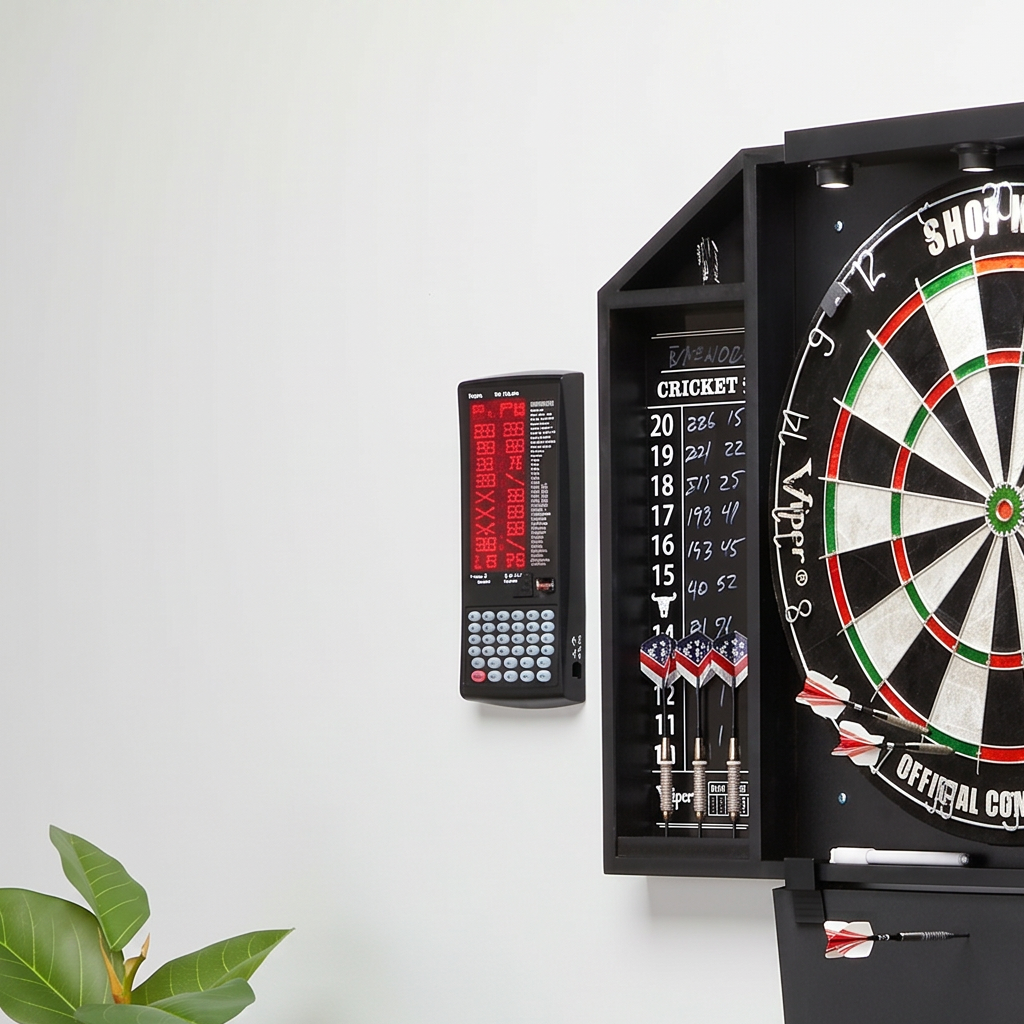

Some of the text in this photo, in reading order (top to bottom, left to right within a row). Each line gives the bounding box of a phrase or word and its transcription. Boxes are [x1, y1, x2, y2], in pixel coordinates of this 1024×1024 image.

[923, 197, 999, 256] SHOT
[657, 377, 739, 399] CRICKET
[650, 413, 674, 437] 20
[650, 444, 674, 467] 19
[650, 474, 674, 496] 18
[651, 504, 675, 526] 17
[651, 533, 675, 556] 16
[652, 564, 675, 586] 15
[655, 714, 675, 735] 11
